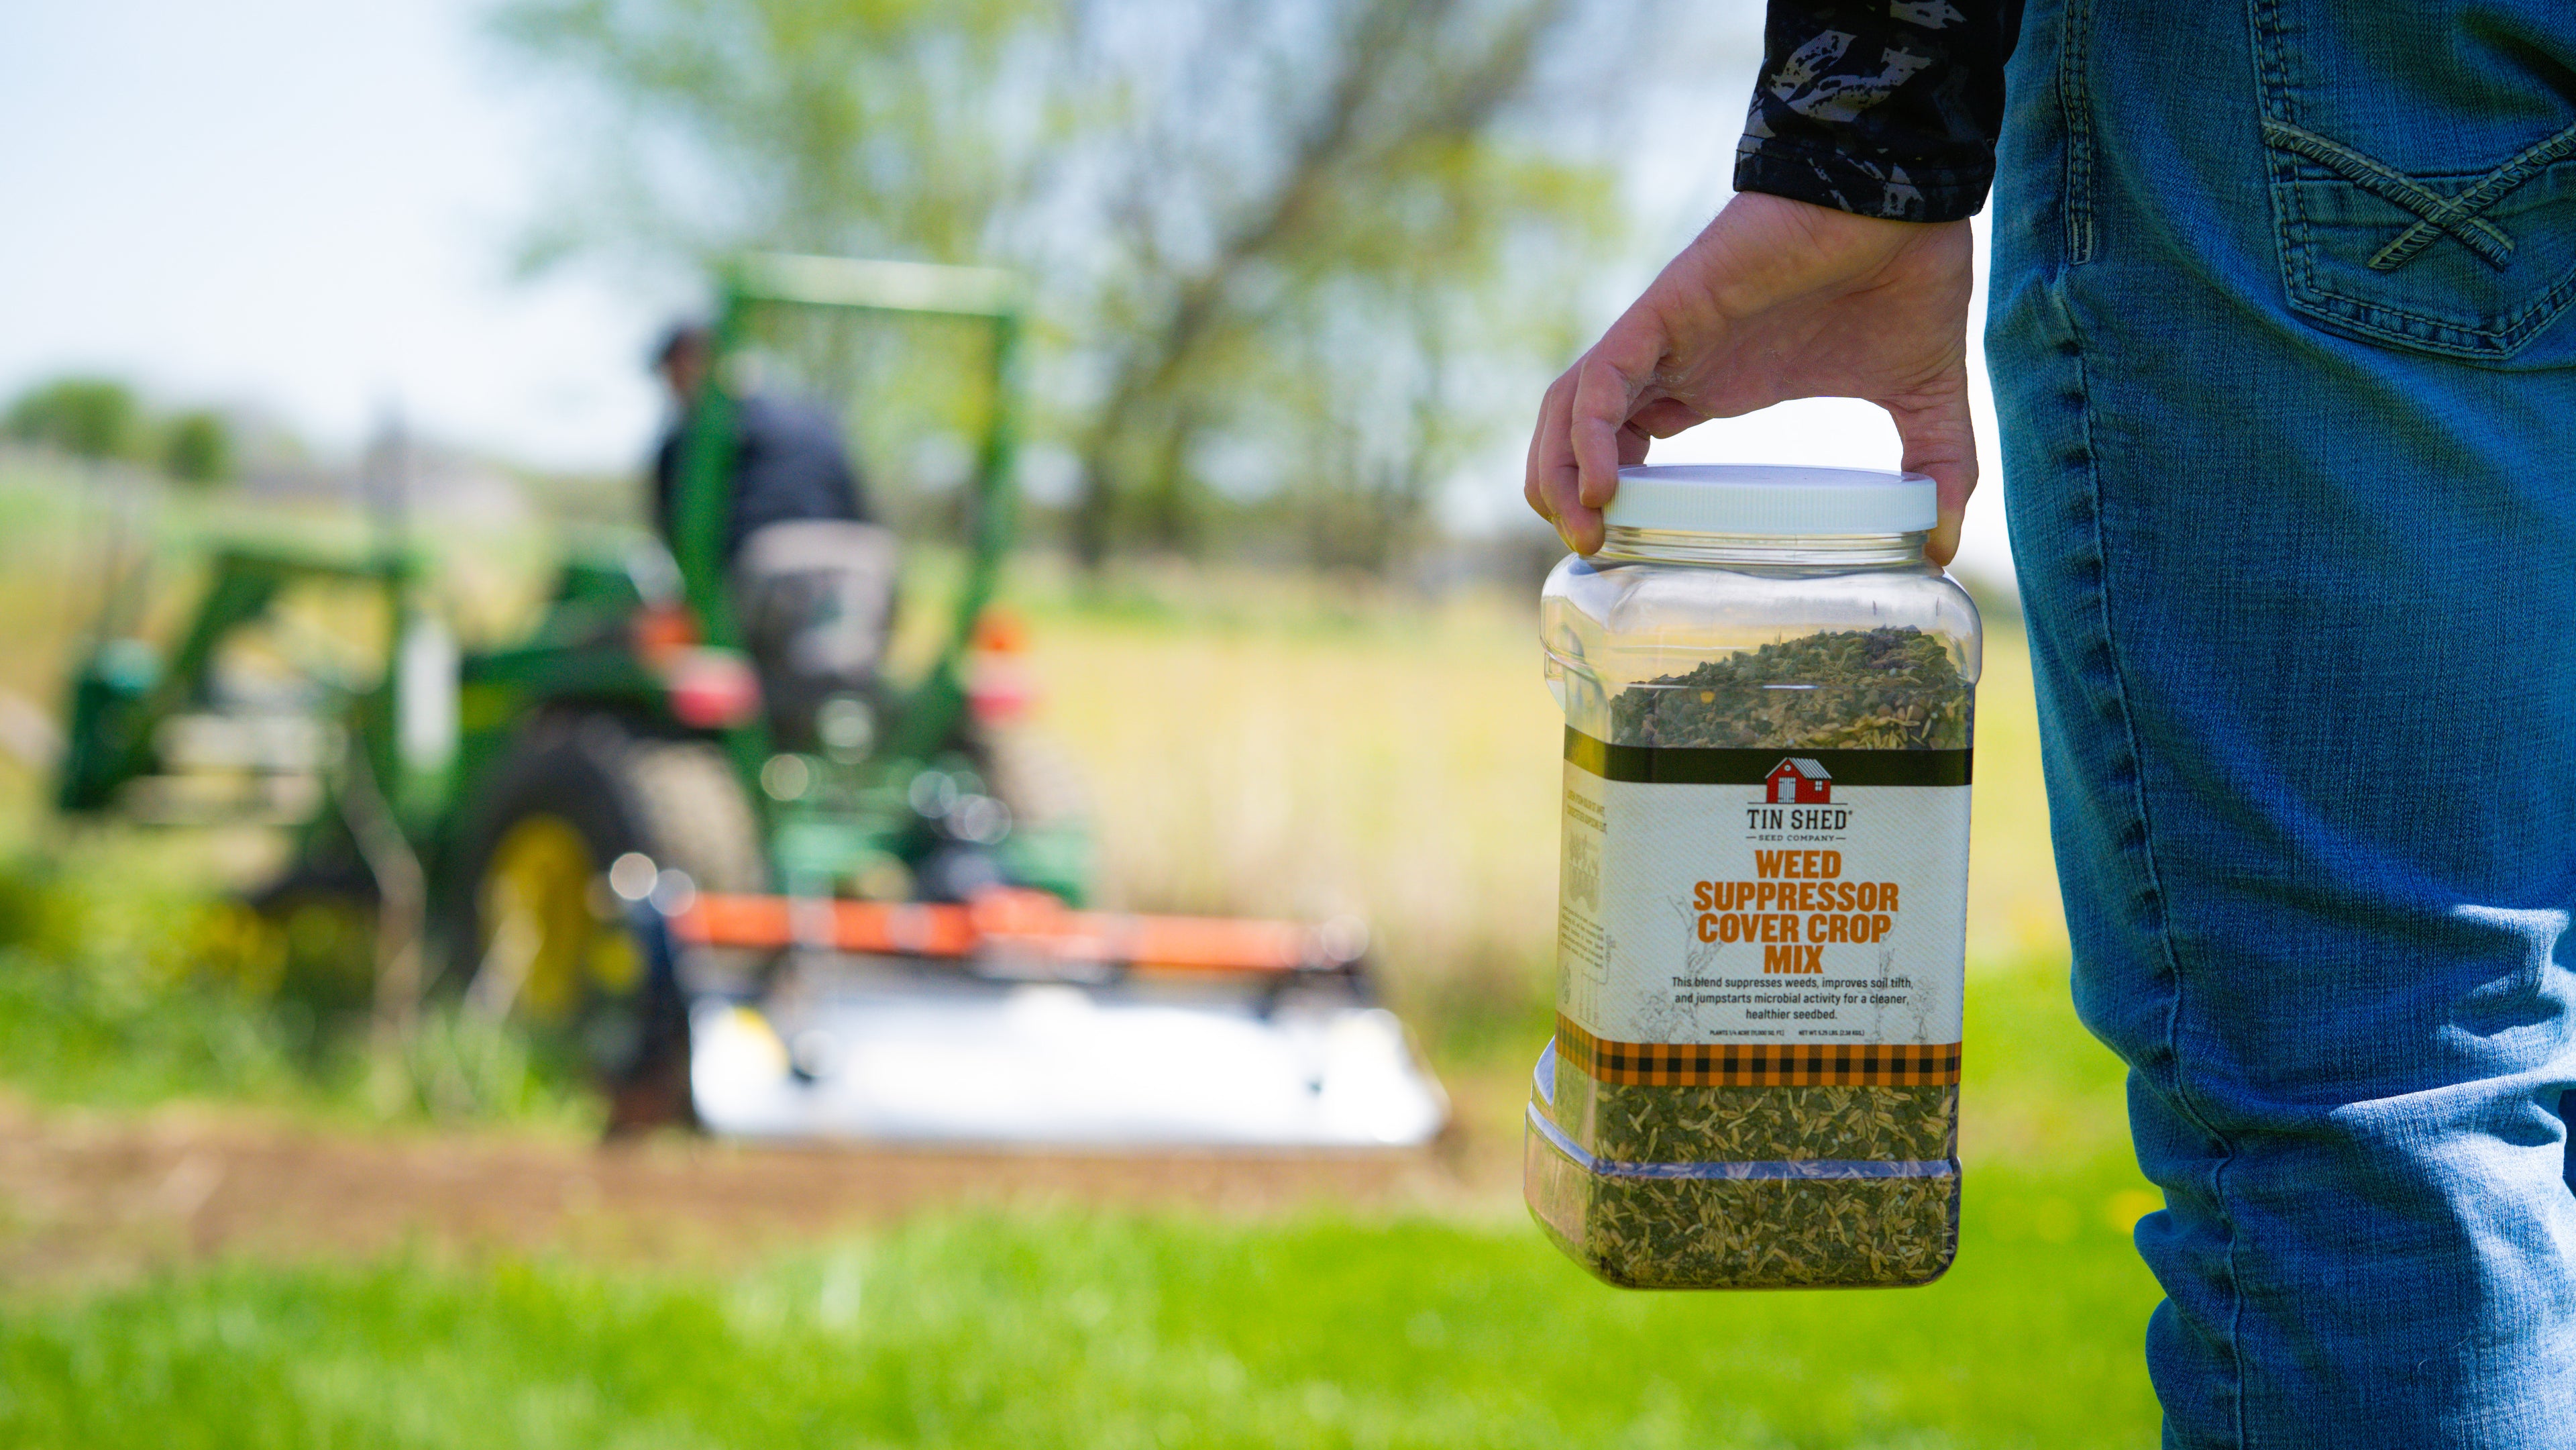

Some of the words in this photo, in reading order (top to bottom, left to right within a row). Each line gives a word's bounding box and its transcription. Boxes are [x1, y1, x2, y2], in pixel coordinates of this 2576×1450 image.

[1747, 809, 1783, 829] TIN
[1755, 849, 1841, 879] WEED
[1693, 880, 1899, 912] SUPPRESSOR
[1697, 913, 1800, 943] COVER
[1807, 913, 1892, 944] CROP
[1764, 945, 1825, 974] MIX
[1672, 977, 1692, 988] This
[1695, 977, 1722, 988] blend
[1725, 978, 1782, 990] suppresses
[1785, 977, 1819, 989] weeds,
[1822, 977, 1868, 990] improves
[1870, 977, 1888, 988] soil
[1890, 977, 1914, 990] tilth,
[1674, 993, 1693, 1004] and
[1695, 992, 1752, 1006] jumpstarts
[1754, 992, 1801, 1004] microbial
[1803, 993, 1841, 1006] activity
[1843, 993, 1859, 1004] for
[1860, 995, 1867, 1004] a
[1869, 993, 1909, 1006] cleaner,
[1746, 1008, 1790, 1019] healthier
[1793, 1009, 1838, 1020] seedbed.
